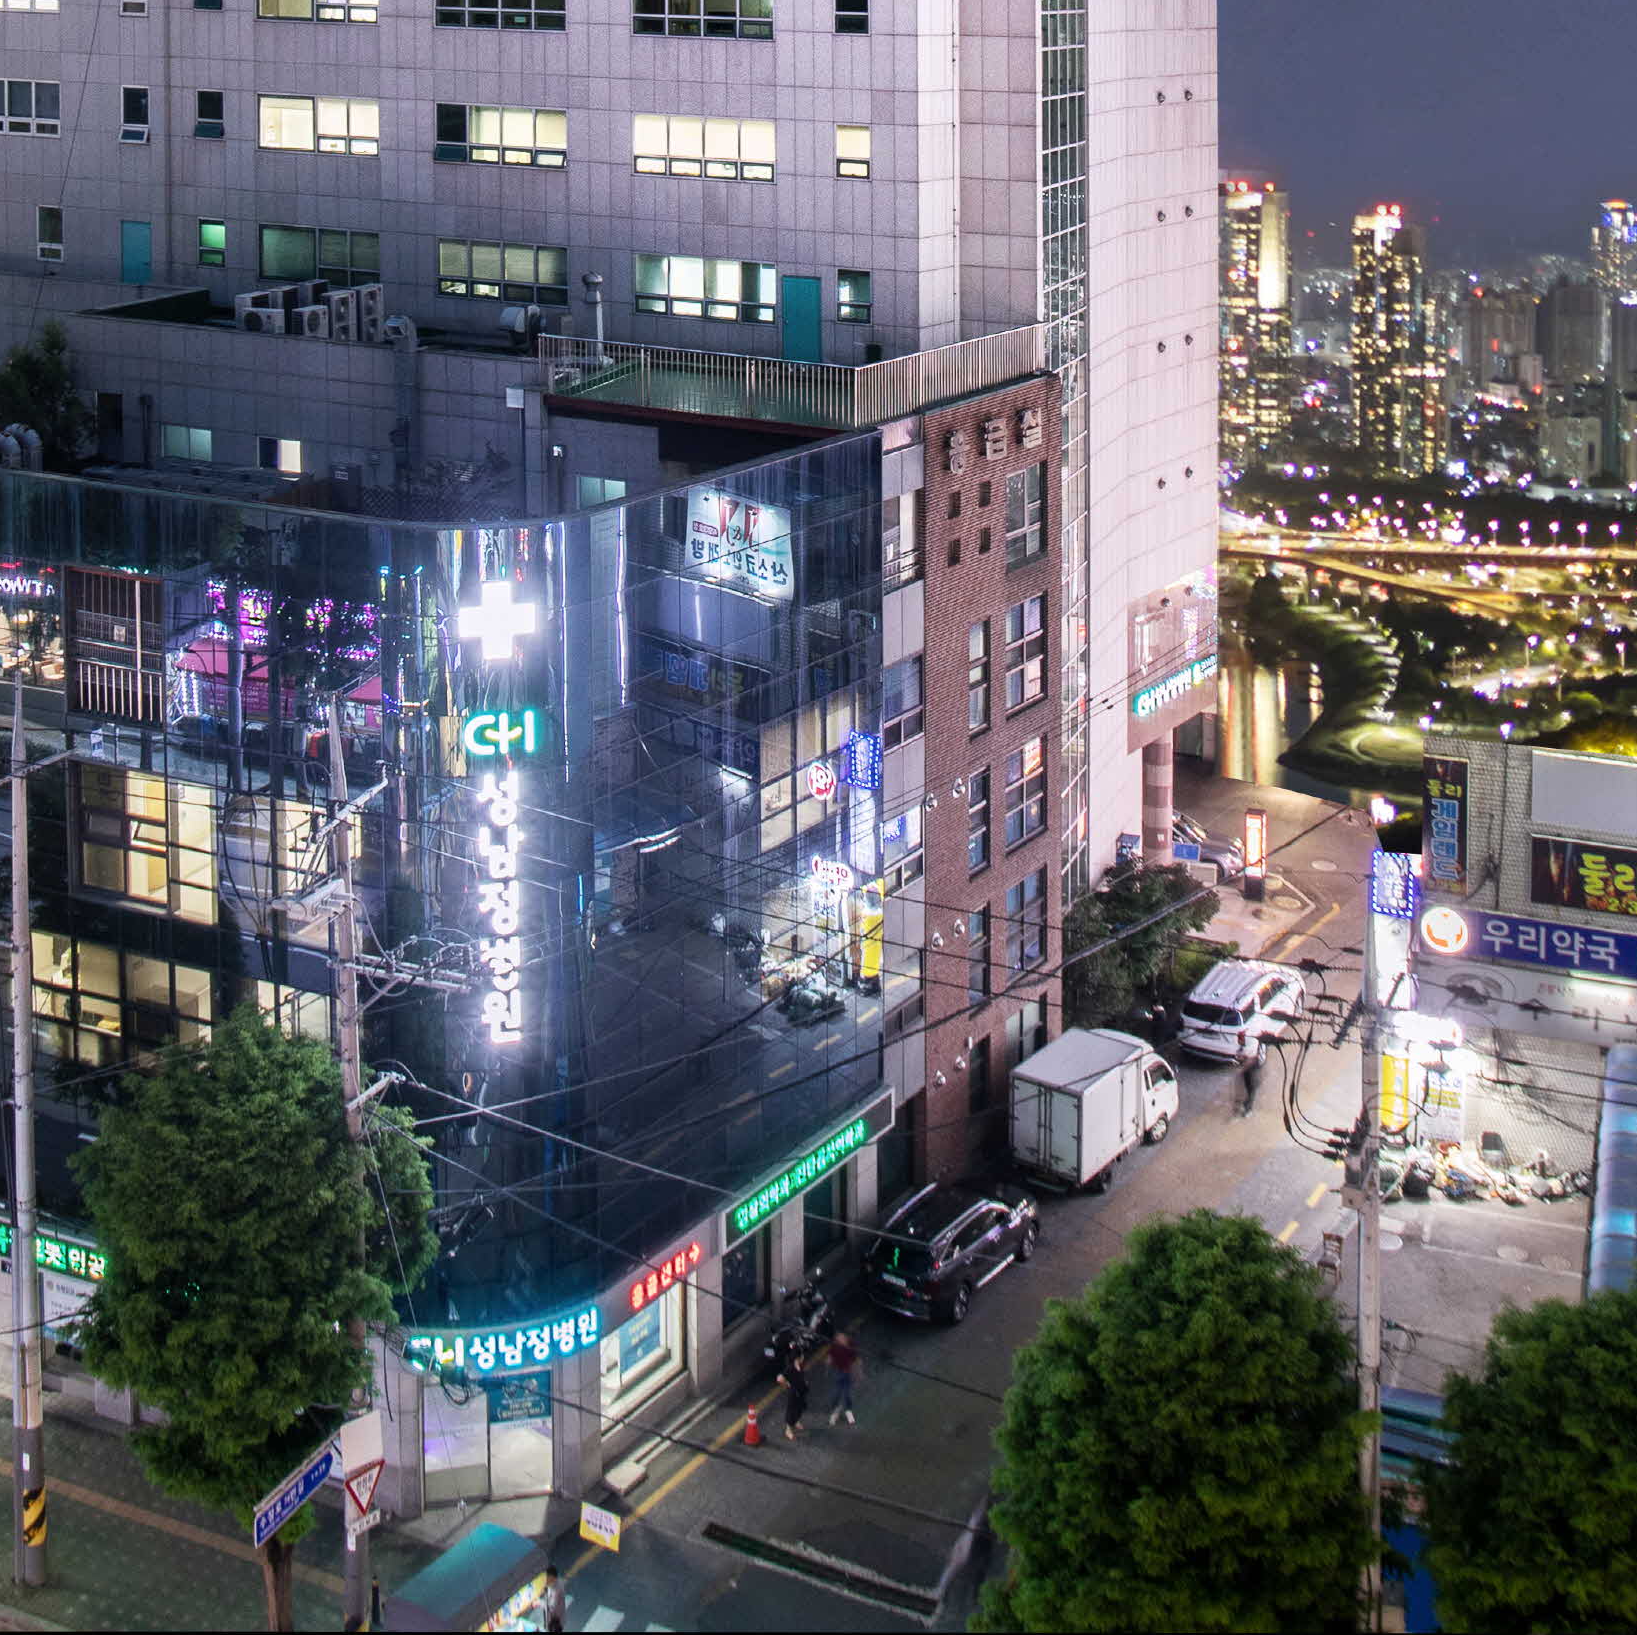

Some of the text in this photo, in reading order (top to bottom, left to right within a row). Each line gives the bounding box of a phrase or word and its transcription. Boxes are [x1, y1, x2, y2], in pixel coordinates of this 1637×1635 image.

[1426, 778, 1462, 798] 둘리
[476, 771, 524, 1044] 성남정병원
[1481, 918, 1621, 971] 우리약국
[468, 1306, 599, 1371] 성남정병원
